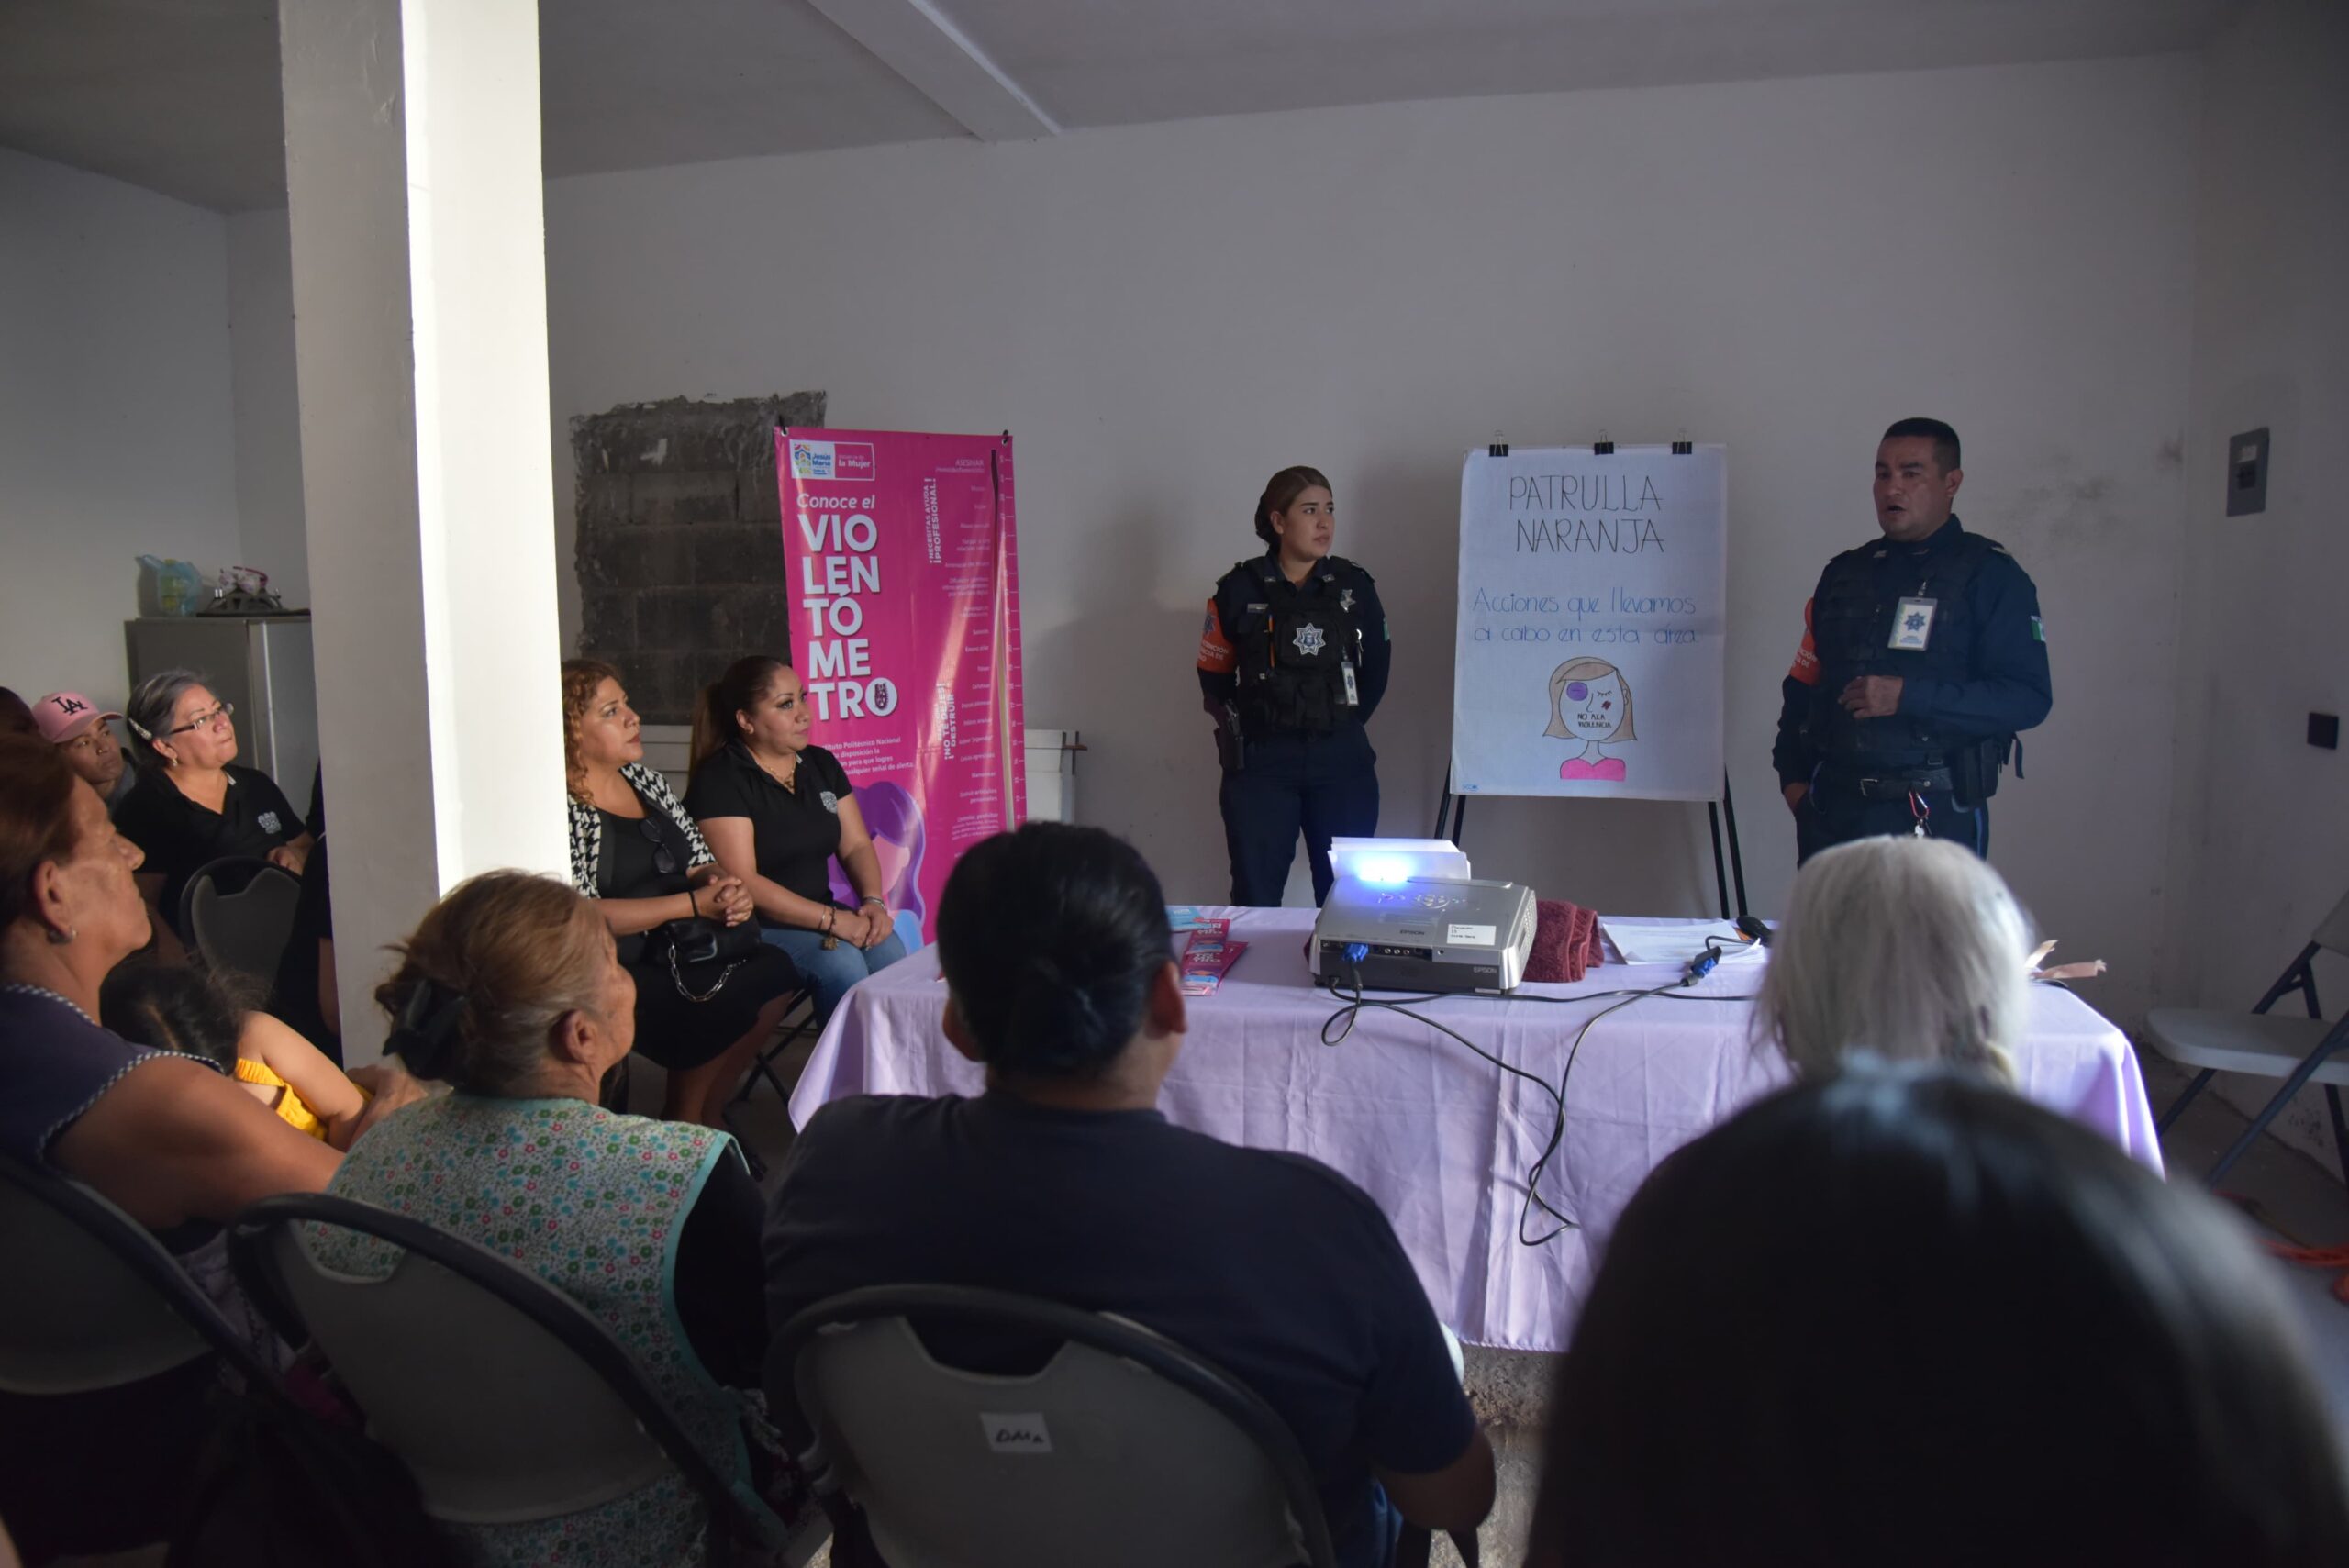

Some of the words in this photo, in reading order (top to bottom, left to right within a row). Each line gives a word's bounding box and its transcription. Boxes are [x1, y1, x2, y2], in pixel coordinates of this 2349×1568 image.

[848, 460, 871, 469] Mujer
[796, 493, 857, 509] Conoce
[862, 495, 875, 509] el
[1509, 474, 1664, 511] PATRULLA
[797, 514, 877, 552] VIO
[1516, 518, 1664, 553] NARANJA
[802, 556, 880, 595] LEN
[1472, 587, 1559, 614] Acciones
[1567, 596, 1600, 622] que
[1611, 587, 1696, 614] llevamos
[1474, 628, 1491, 642] a
[1501, 625, 1550, 642] cabo
[1559, 628, 1581, 642] en
[1592, 625, 1640, 643] esta
[808, 638, 872, 680] ME
[51, 696, 88, 716] LA
[808, 676, 897, 720] TRO
[876, 737, 901, 745] Nacional
[841, 750, 874, 758] disposición
[875, 755, 893, 764] logres
[845, 767, 872, 775] ualquier
